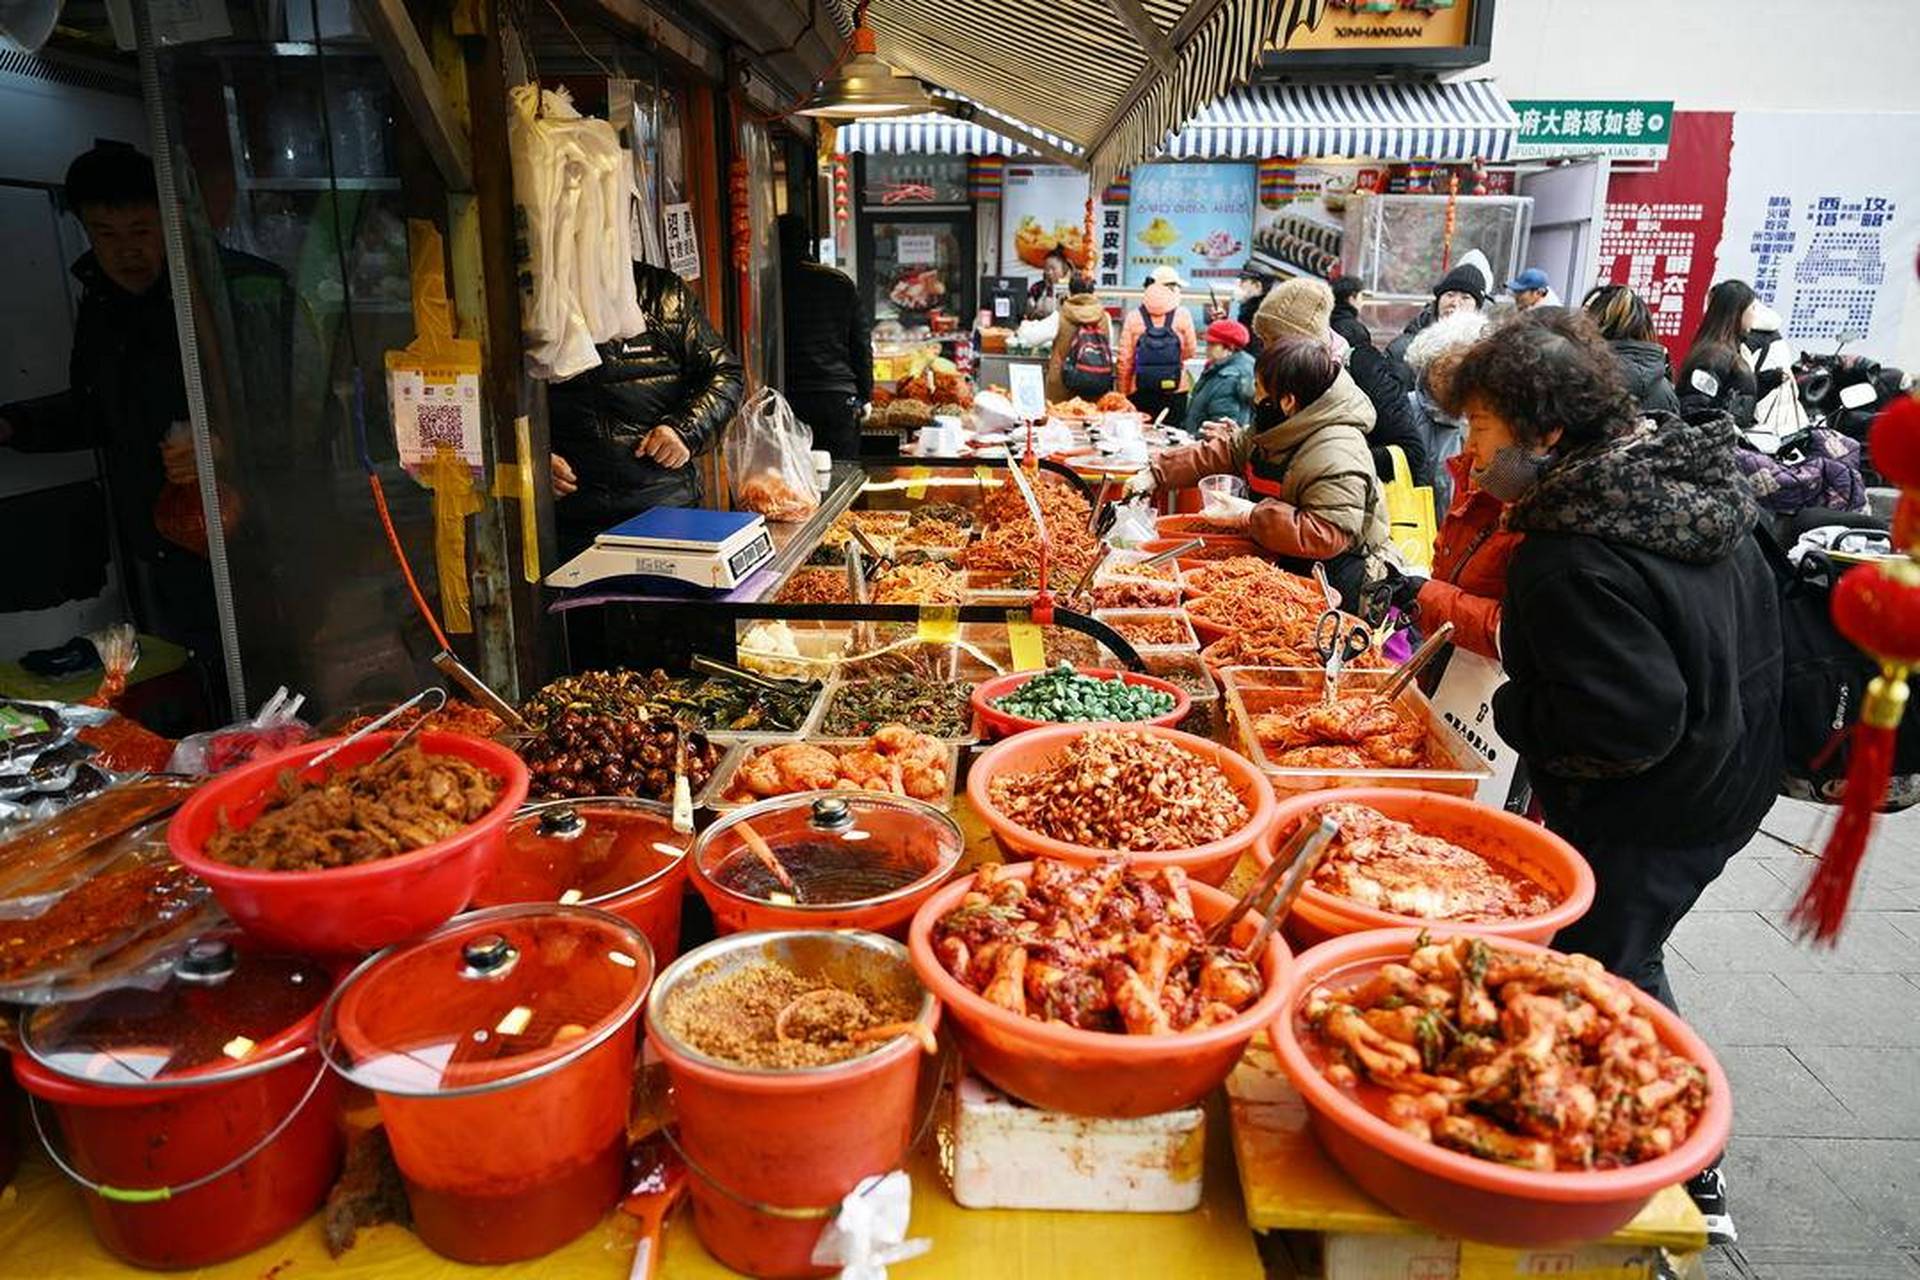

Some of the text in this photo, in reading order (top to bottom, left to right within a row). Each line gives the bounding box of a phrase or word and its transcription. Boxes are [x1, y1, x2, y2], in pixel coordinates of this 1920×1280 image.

[1334, 26, 1423, 38] XINHANXIAN
[1516, 108, 1646, 137] 府大路琢如巷
[1768, 196, 1792, 207] 部队
[1102, 210, 1120, 286] 豆皮寿司
